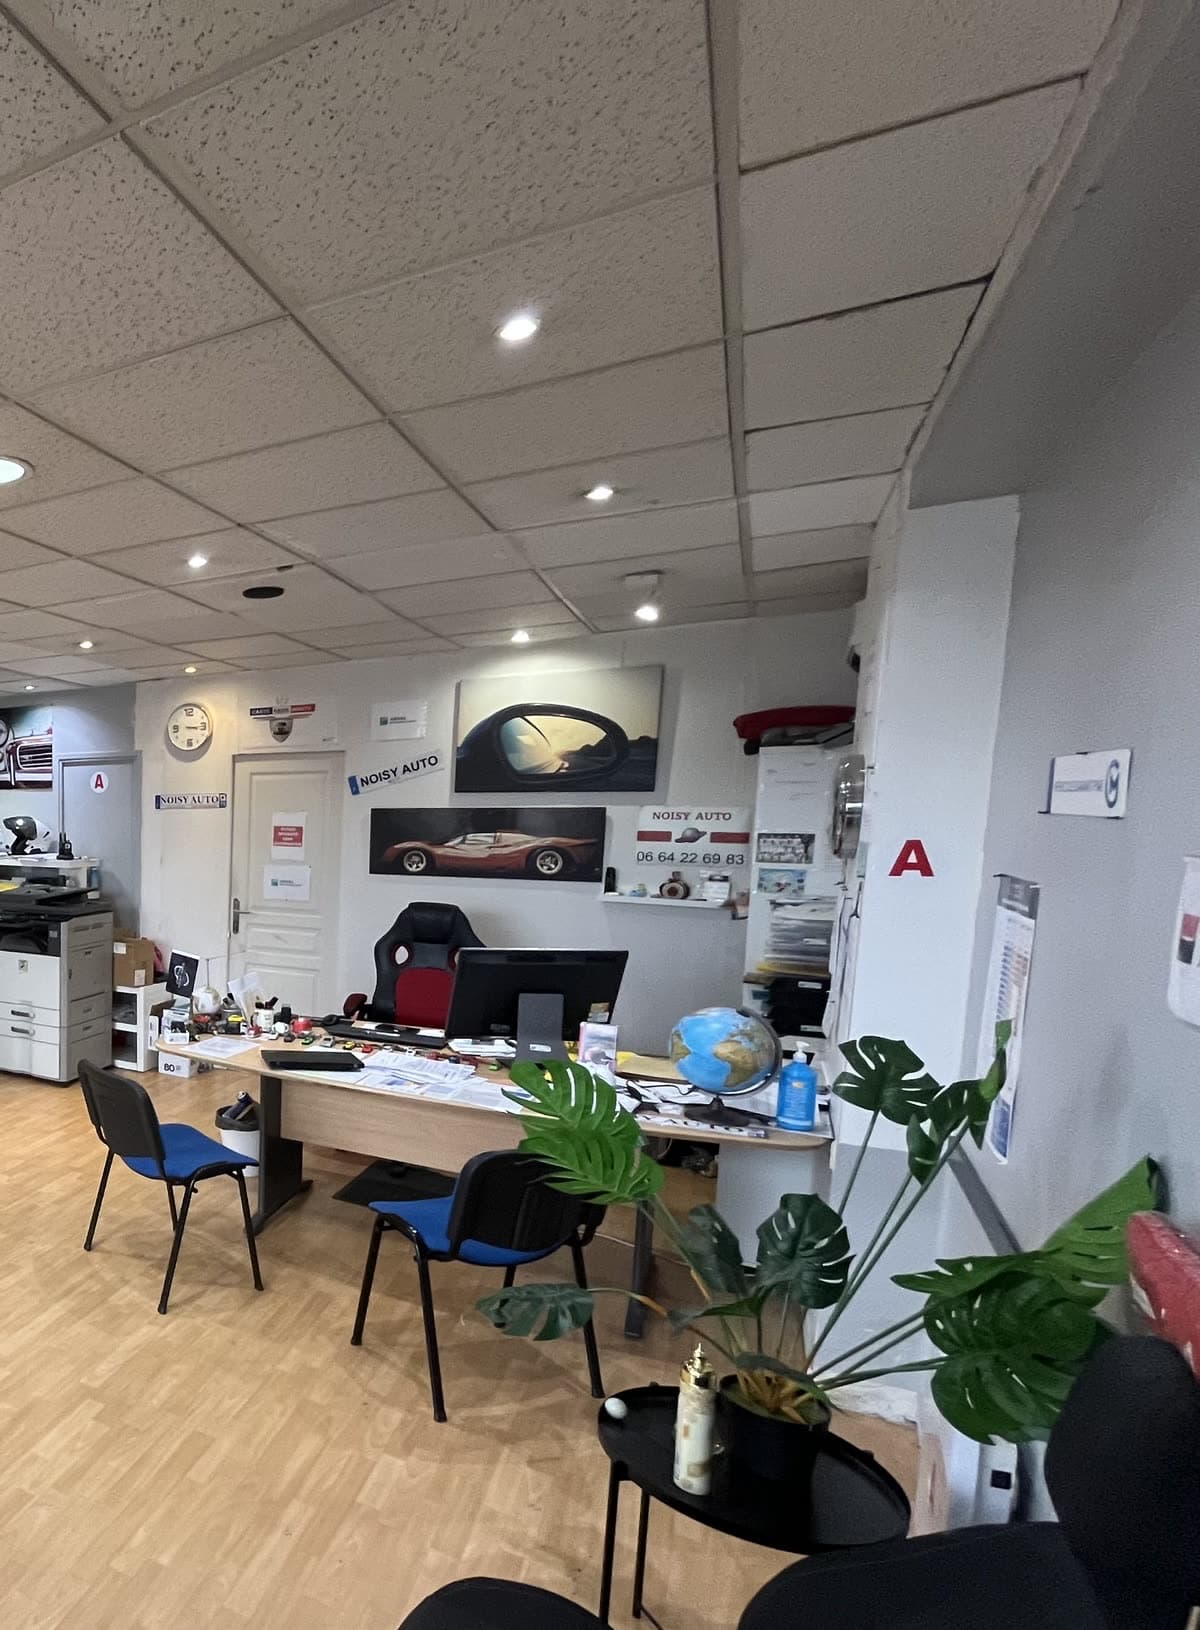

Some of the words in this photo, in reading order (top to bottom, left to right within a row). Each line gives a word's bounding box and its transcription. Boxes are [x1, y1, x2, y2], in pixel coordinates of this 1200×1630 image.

[184, 708, 194, 717] 12
[172, 724, 179, 733] 9
[200, 721, 207, 731] 3
[360, 767, 398, 787] NOISY
[402, 755, 439, 775] AUTO
[94, 774, 104, 789] A
[160, 795, 188, 804] NOISY
[192, 795, 219, 804] AUTO
[652, 811, 690, 821] NOISY
[695, 811, 732, 821] AUTO
[636, 851, 654, 862] 06
[658, 851, 675, 863] 64
[679, 852, 698, 864] 22
[702, 853, 721, 864] 69
[726, 853, 745, 865] 83
[888, 839, 935, 877] A
